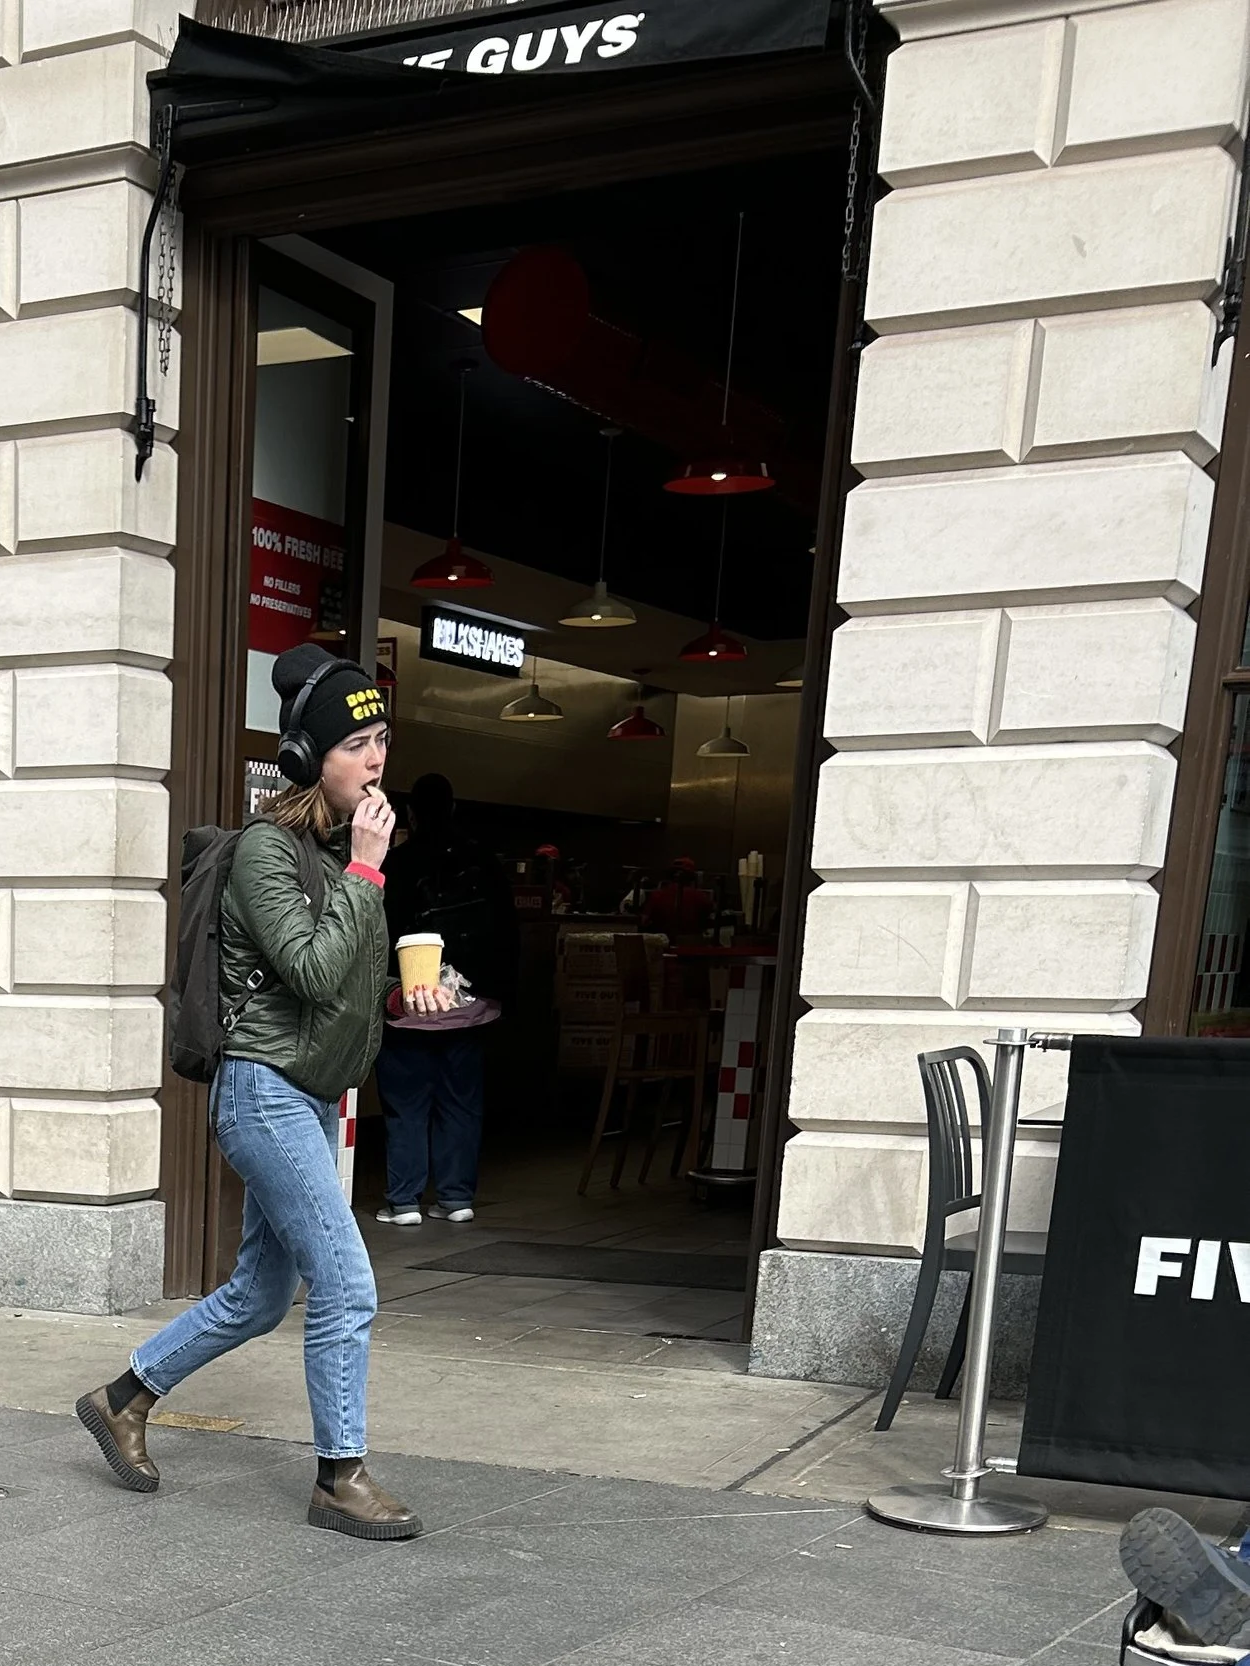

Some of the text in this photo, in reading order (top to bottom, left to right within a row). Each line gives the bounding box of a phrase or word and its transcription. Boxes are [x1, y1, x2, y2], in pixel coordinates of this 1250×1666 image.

[466, 13, 644, 74] GUYS
[251, 526, 282, 553] 100%
[284, 535, 321, 565] FRESH
[263, 575, 301, 596] NO FILLERS
[250, 593, 312, 619] NO PRESERVATIVES
[432, 617, 525, 668] MILKSHAKES
